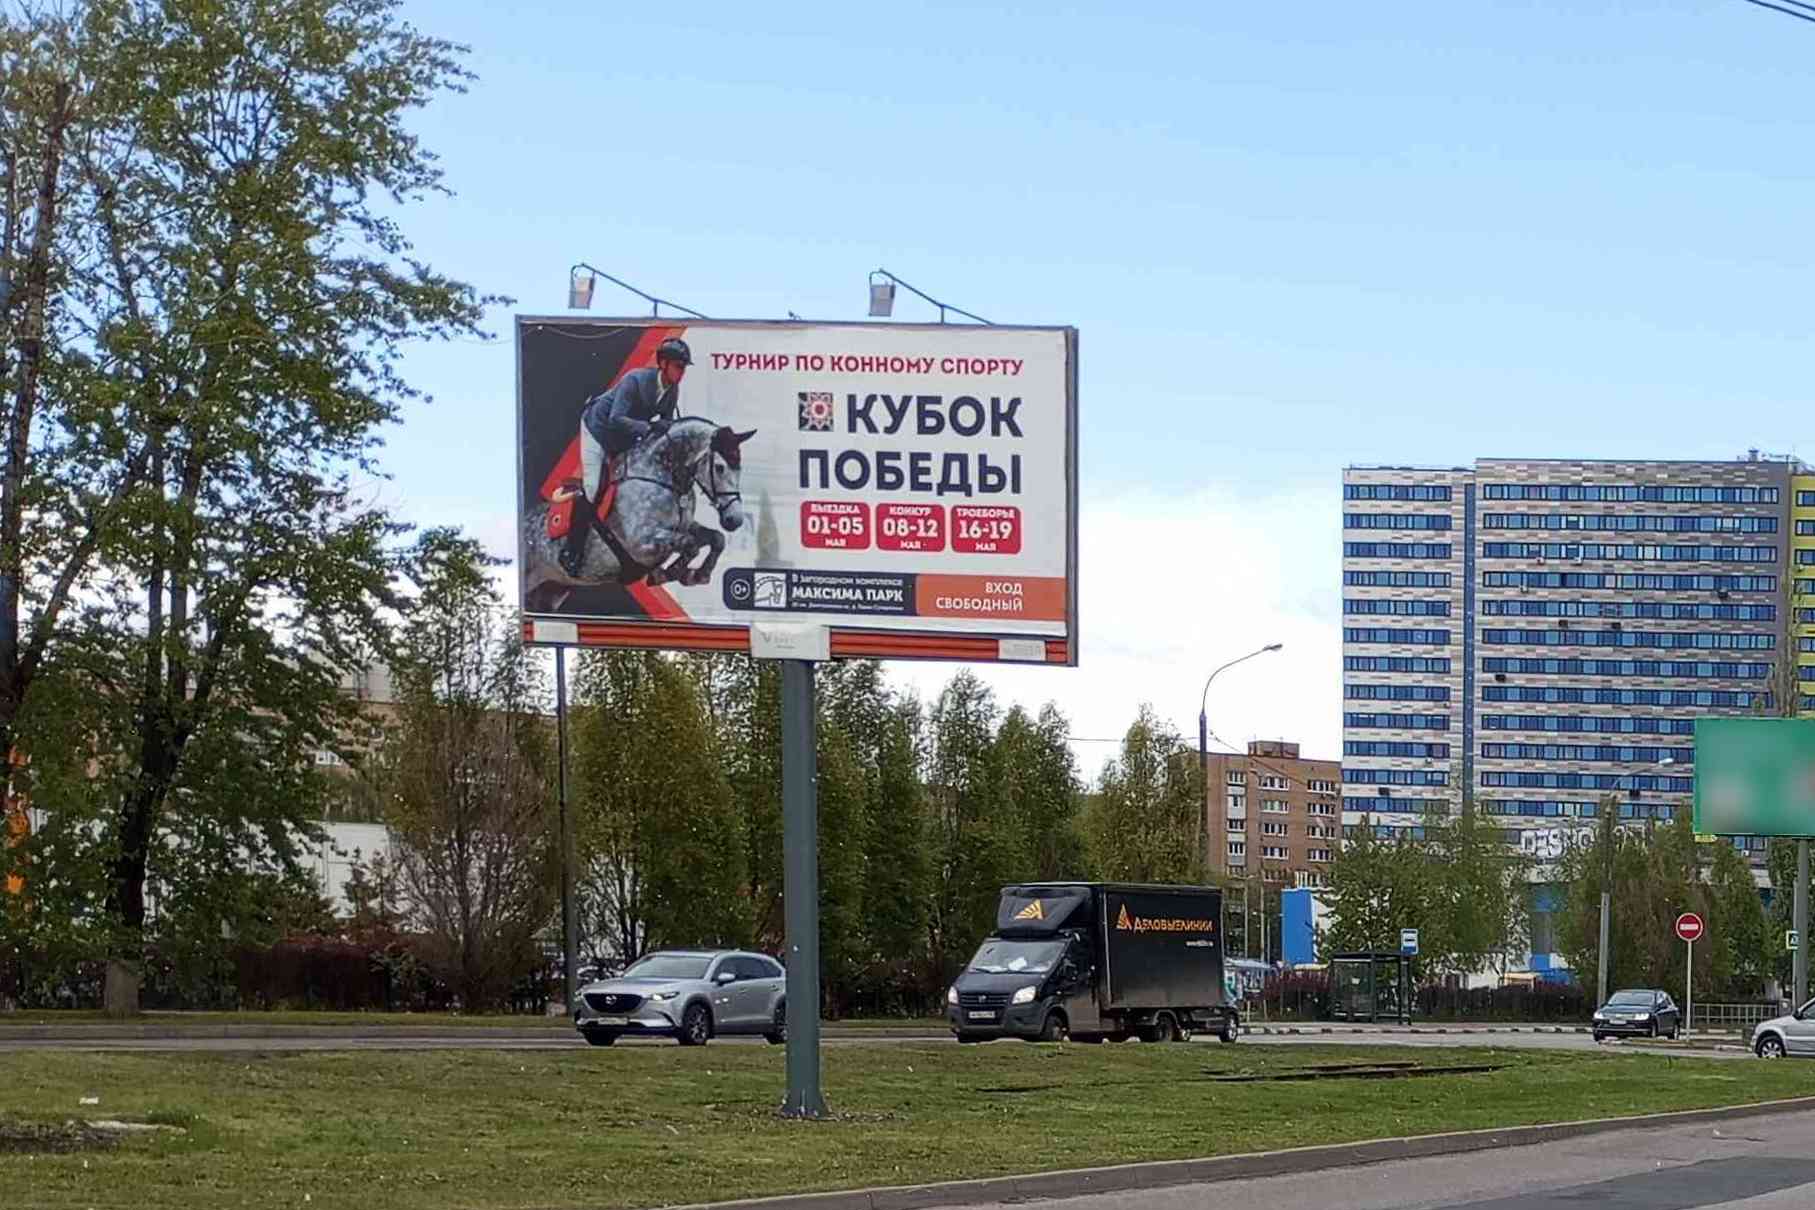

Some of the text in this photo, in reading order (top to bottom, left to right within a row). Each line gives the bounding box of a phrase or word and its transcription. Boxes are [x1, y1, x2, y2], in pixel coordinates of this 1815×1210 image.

[711, 353, 1024, 376] ТУРНИР ПО КОННОМУ СПОРТУ
[847, 393, 1023, 437] КУБОК
[800, 449, 1022, 497] ПОБЕДЫ
[807, 516, 864, 535] 01-05
[882, 519, 938, 538] 08-12
[959, 520, 1013, 540] 16-19
[791, 586, 904, 602] МАКСИМА ПАРК
[985, 582, 1024, 595] ВХОД
[936, 597, 1023, 611] СВОБОДНЫЙ
